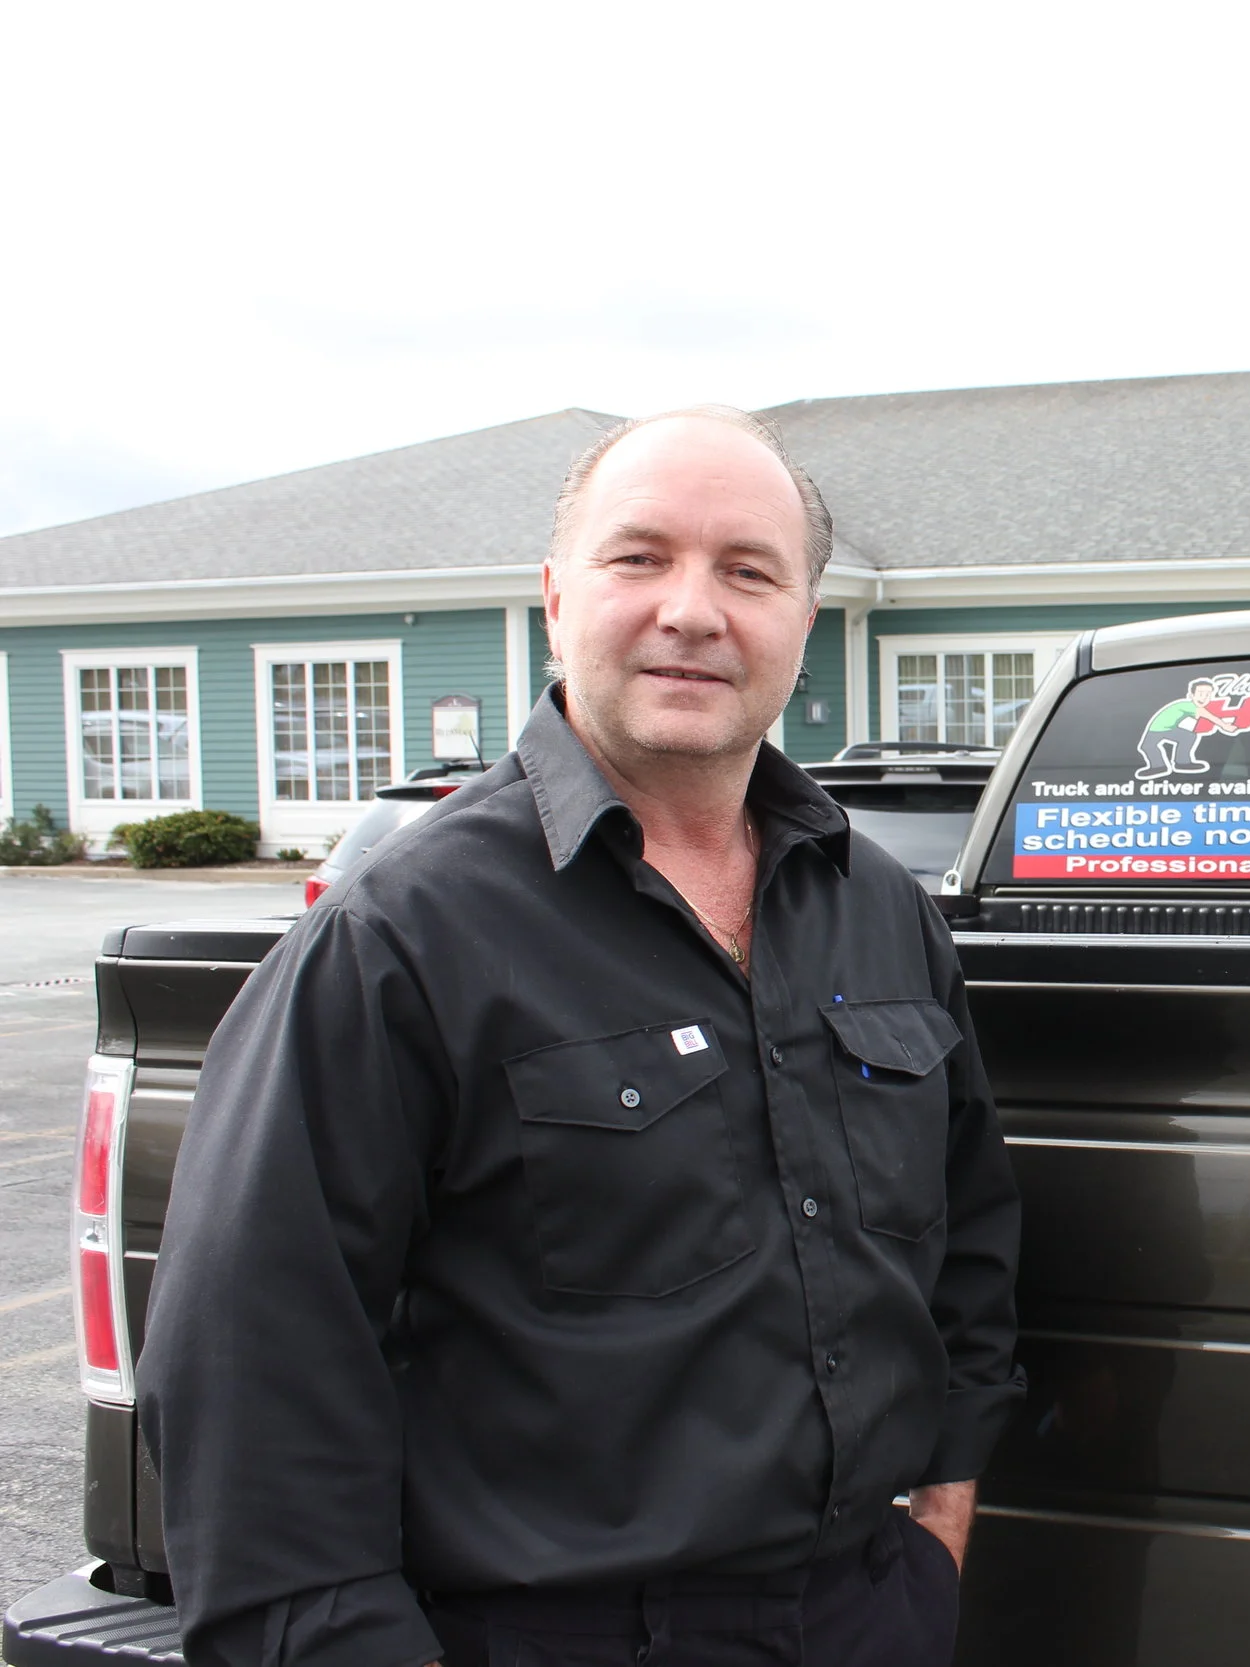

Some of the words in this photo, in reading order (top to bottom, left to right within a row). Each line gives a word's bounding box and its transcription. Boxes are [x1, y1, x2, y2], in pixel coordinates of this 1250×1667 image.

[1032, 780, 1089, 796] Truck
[1095, 780, 1134, 796] and
[1140, 780, 1204, 796] driver
[1037, 805, 1182, 828] Flexible
[1022, 827, 1192, 851] schedule
[681, 1033, 695, 1041] BIG
